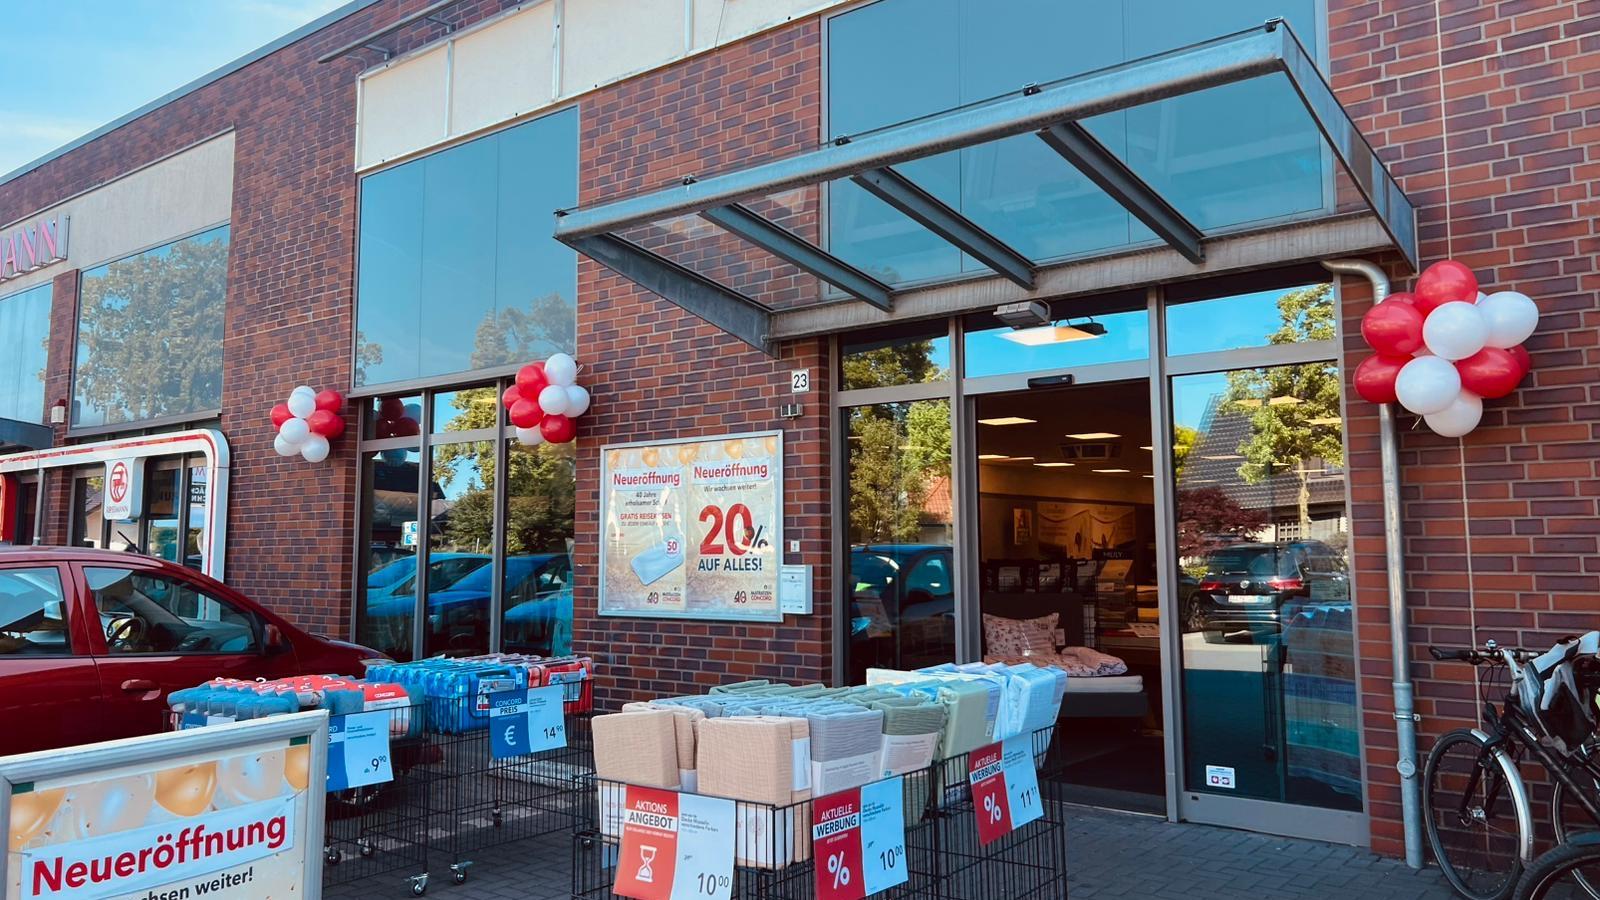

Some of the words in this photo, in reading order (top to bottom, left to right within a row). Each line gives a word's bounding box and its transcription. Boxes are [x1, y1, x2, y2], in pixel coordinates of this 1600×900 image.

[0, 214, 59, 279] ANN
[793, 373, 807, 389] 23
[613, 471, 680, 486] Neueröffnung
[693, 462, 768, 479] Neueröffnung
[667, 541, 678, 551] 50
[698, 558, 721, 571] AUF
[723, 557, 763, 571] ALLES!
[495, 698, 522, 707] CONCORD
[500, 705, 518, 715] PREIS
[974, 752, 998, 770] AKTUELLE
[971, 762, 1001, 782] WERBUNG
[635, 800, 668, 814] AKTIONS
[821, 803, 853, 822] AKTUELLE
[628, 811, 673, 829] ANGEBOT
[816, 815, 857, 837] WERBUNG
[32, 815, 286, 896] Neueröffnung
[195, 866, 253, 895] weiter!
